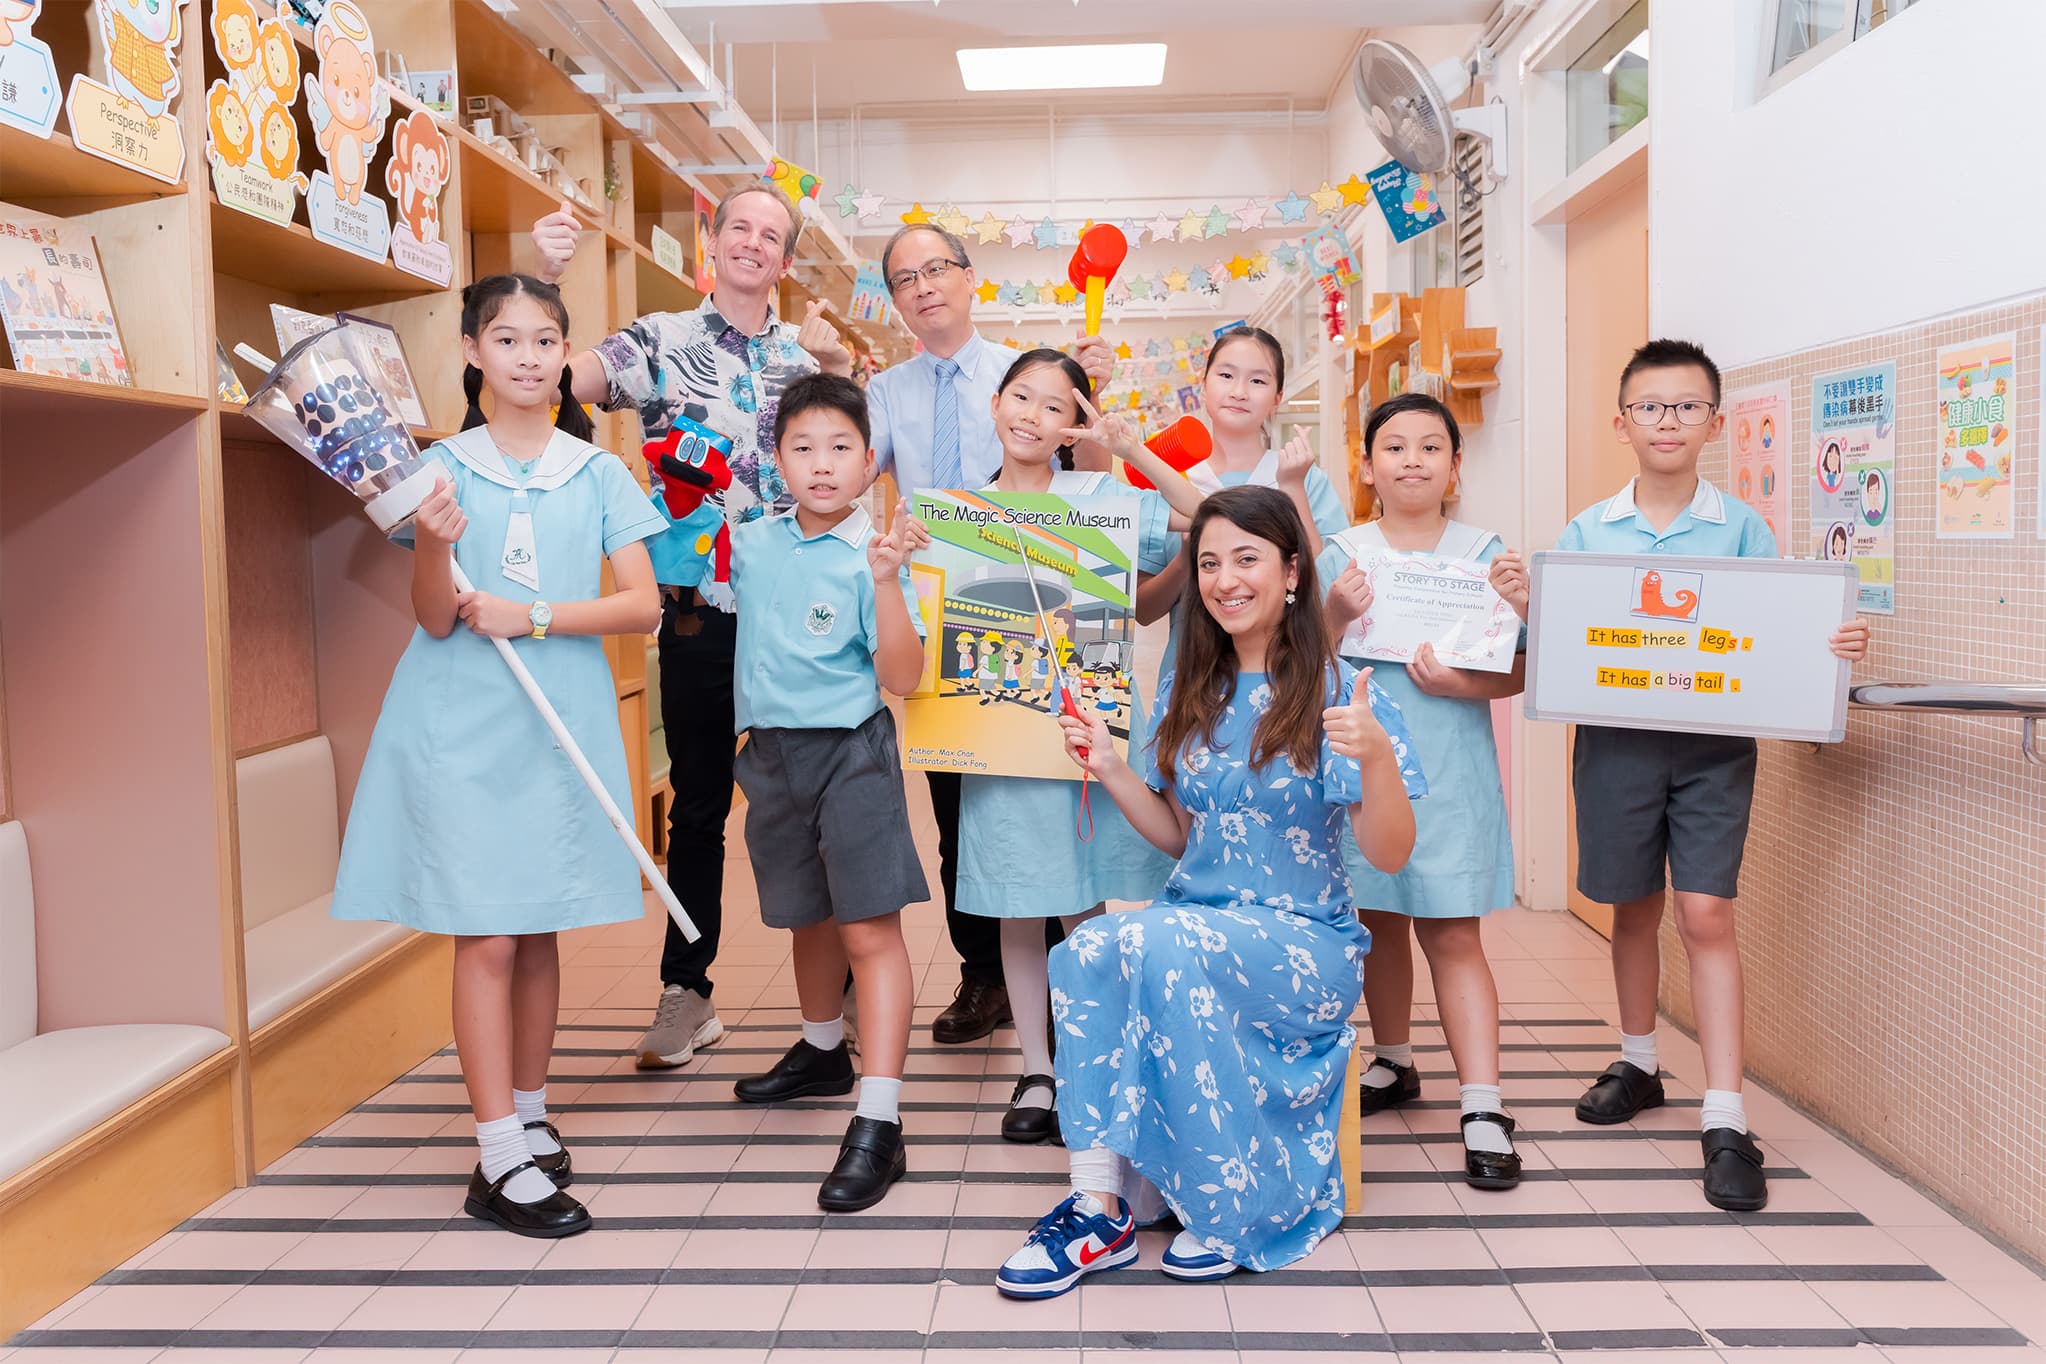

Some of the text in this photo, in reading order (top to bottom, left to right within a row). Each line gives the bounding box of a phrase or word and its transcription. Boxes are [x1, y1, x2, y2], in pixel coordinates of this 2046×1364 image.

[100, 102, 158, 140] Perspective
[111, 130, 149, 161] 洞察力
[240, 168, 273, 192] Teamwork
[1823, 373, 1884, 400] 不要讓雙手變成
[1823, 394, 1884, 419] 傳染病幕後黑手
[1948, 394, 2005, 428] 健康小食
[920, 504, 1131, 529] The Magic Science Museum
[1025, 545, 1079, 577] Museum
[1393, 572, 1429, 585] STORY
[1432, 578, 1448, 588] TO
[1450, 580, 1486, 592] STAGE
[1386, 594, 1426, 605] Certificate
[1438, 600, 1485, 610] Appreciation
[1589, 629, 1606, 642] It
[1611, 630, 1637, 644] has
[1641, 632, 1687, 646] three
[1599, 670, 1616, 683] It
[1621, 672, 1647, 686] has
[1654, 675, 1664, 686] a
[1668, 673, 1692, 690] big
[1696, 675, 1722, 689] tail
[939, 748, 954, 756] Max
[956, 749, 974, 757] Chan
[952, 758, 968, 767] Dick
[970, 760, 988, 769] Fong
